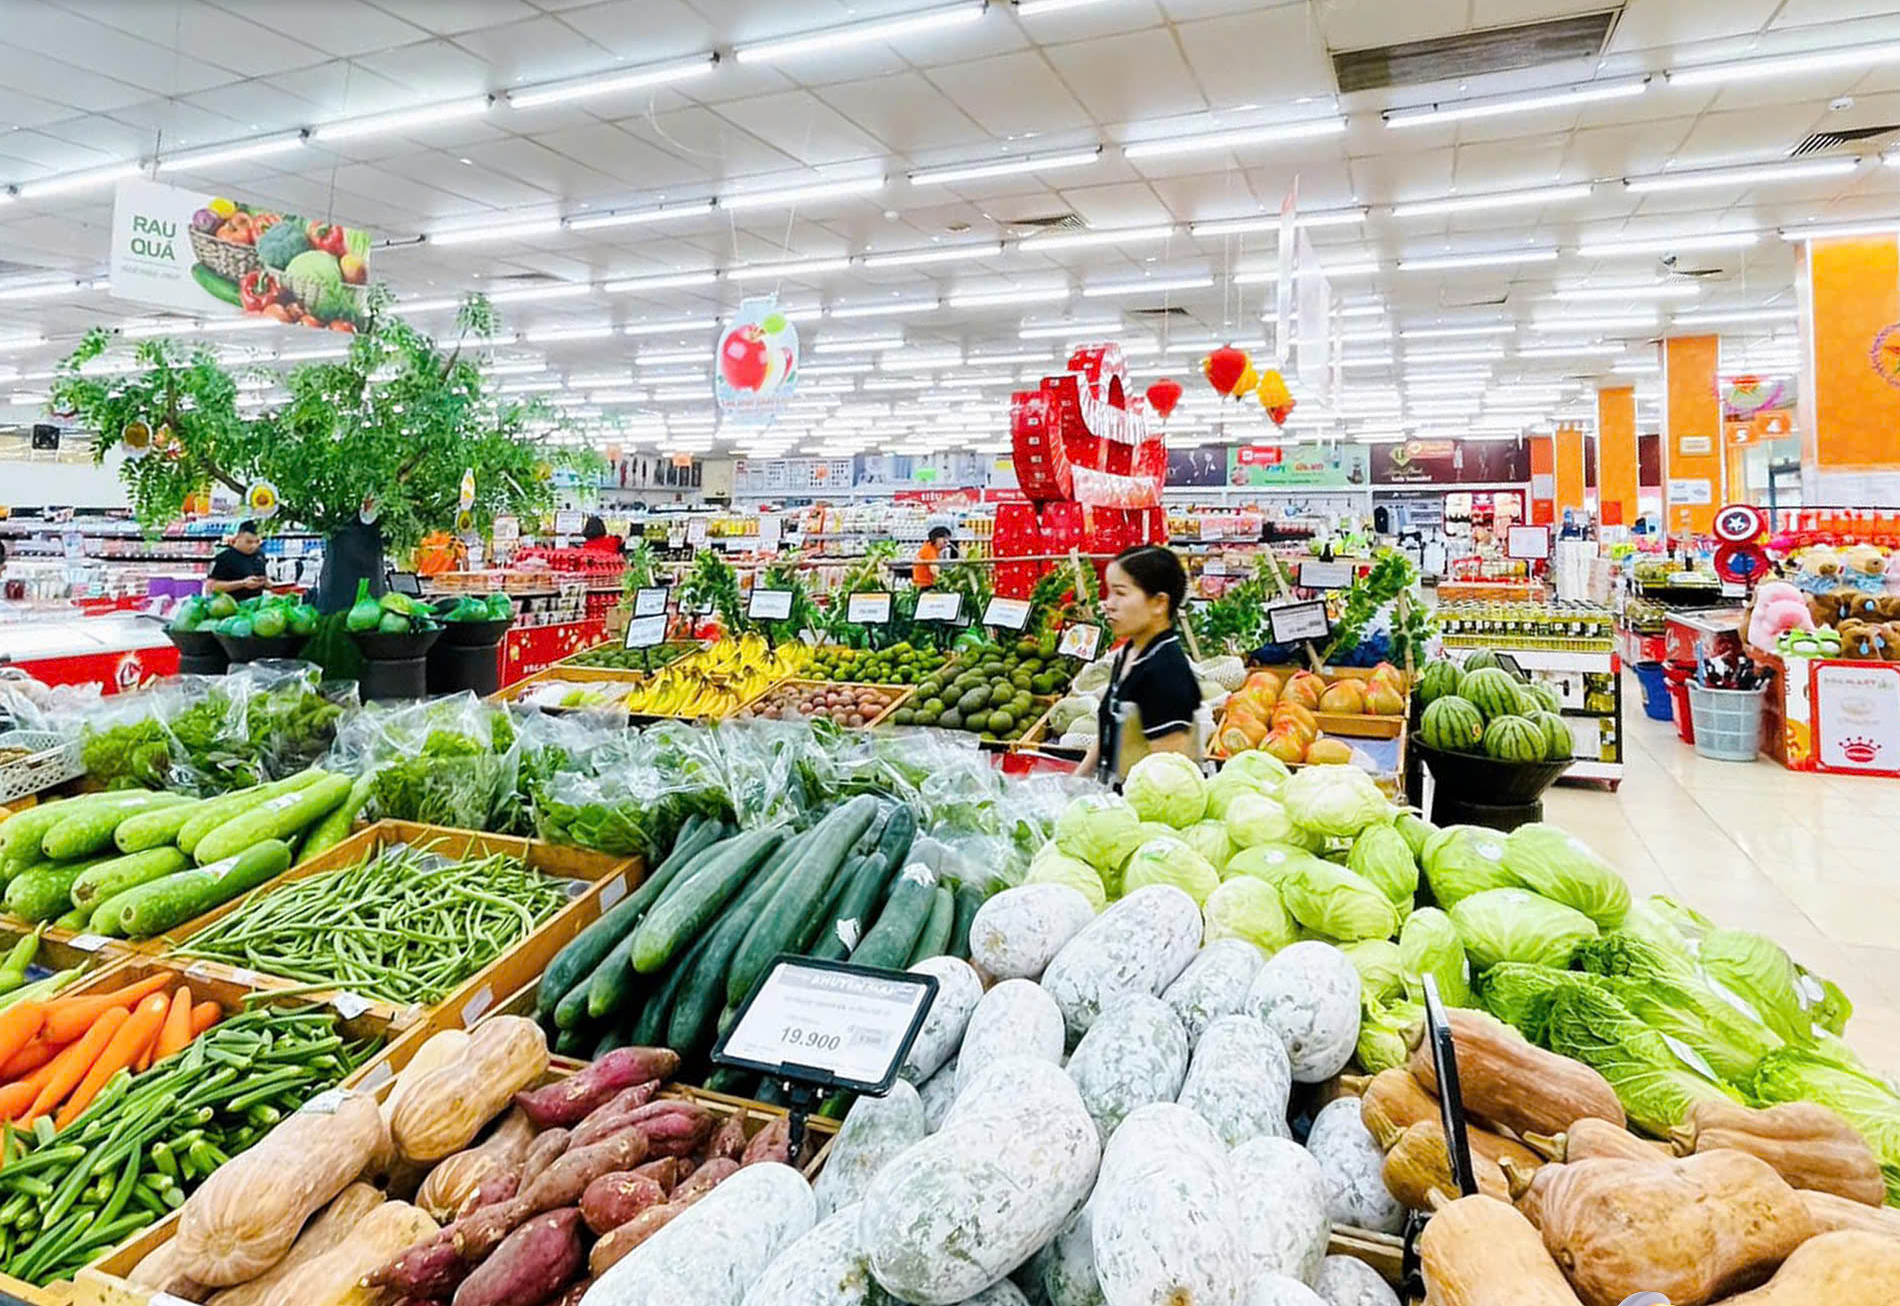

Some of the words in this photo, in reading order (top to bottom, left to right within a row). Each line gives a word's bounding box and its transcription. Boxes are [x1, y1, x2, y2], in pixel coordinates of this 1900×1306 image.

[133, 215, 176, 238] RAU
[1736, 429, 1748, 442] 5
[780, 1026, 841, 1051] 19.900
